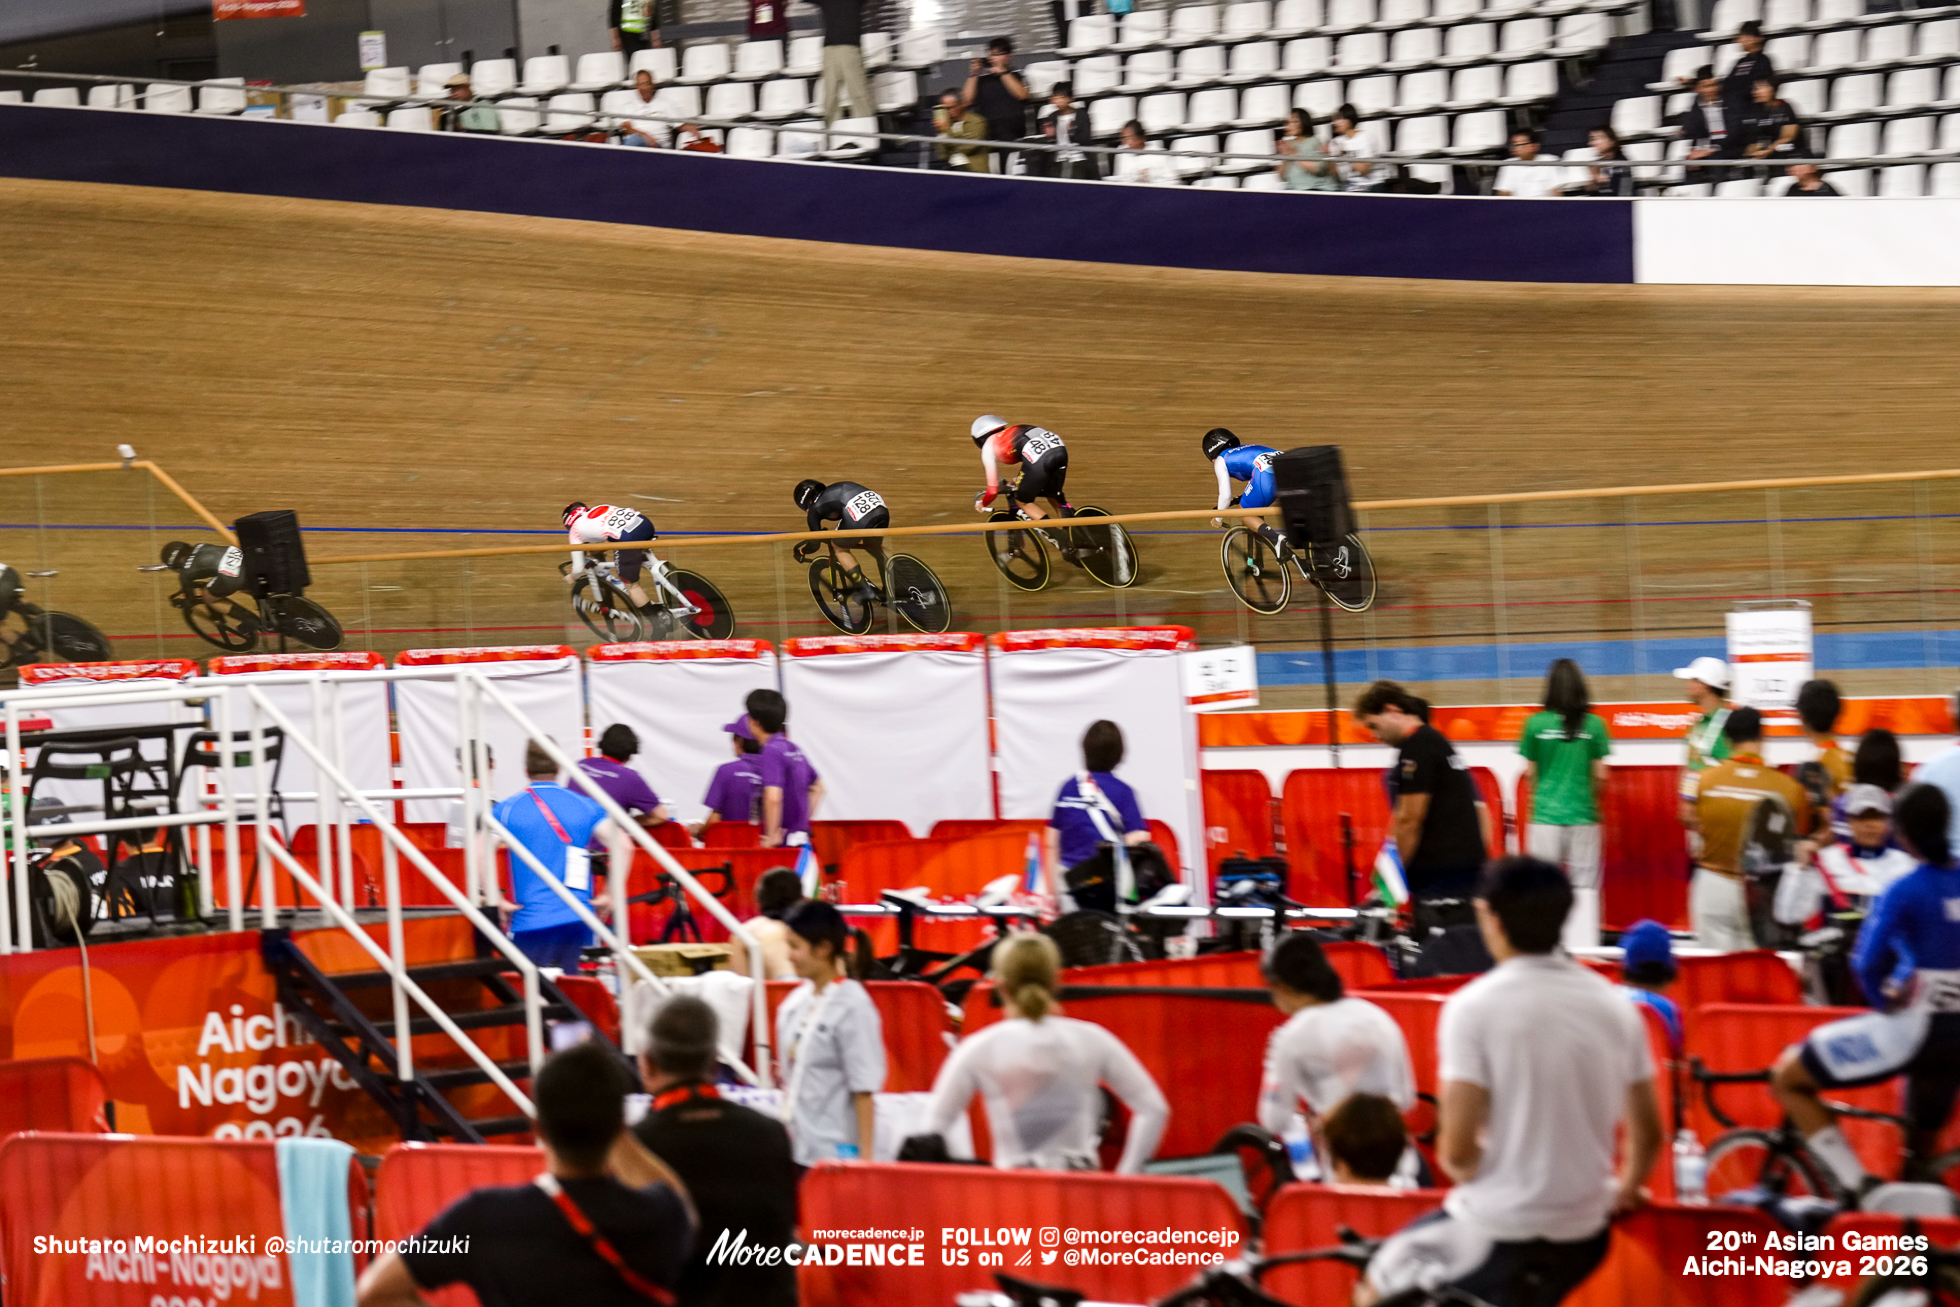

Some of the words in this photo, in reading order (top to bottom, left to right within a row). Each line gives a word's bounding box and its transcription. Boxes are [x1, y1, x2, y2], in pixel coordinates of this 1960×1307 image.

[1029, 439, 1047, 455] 48
[852, 495, 871, 514] 128
[197, 1002, 315, 1056] Aich
